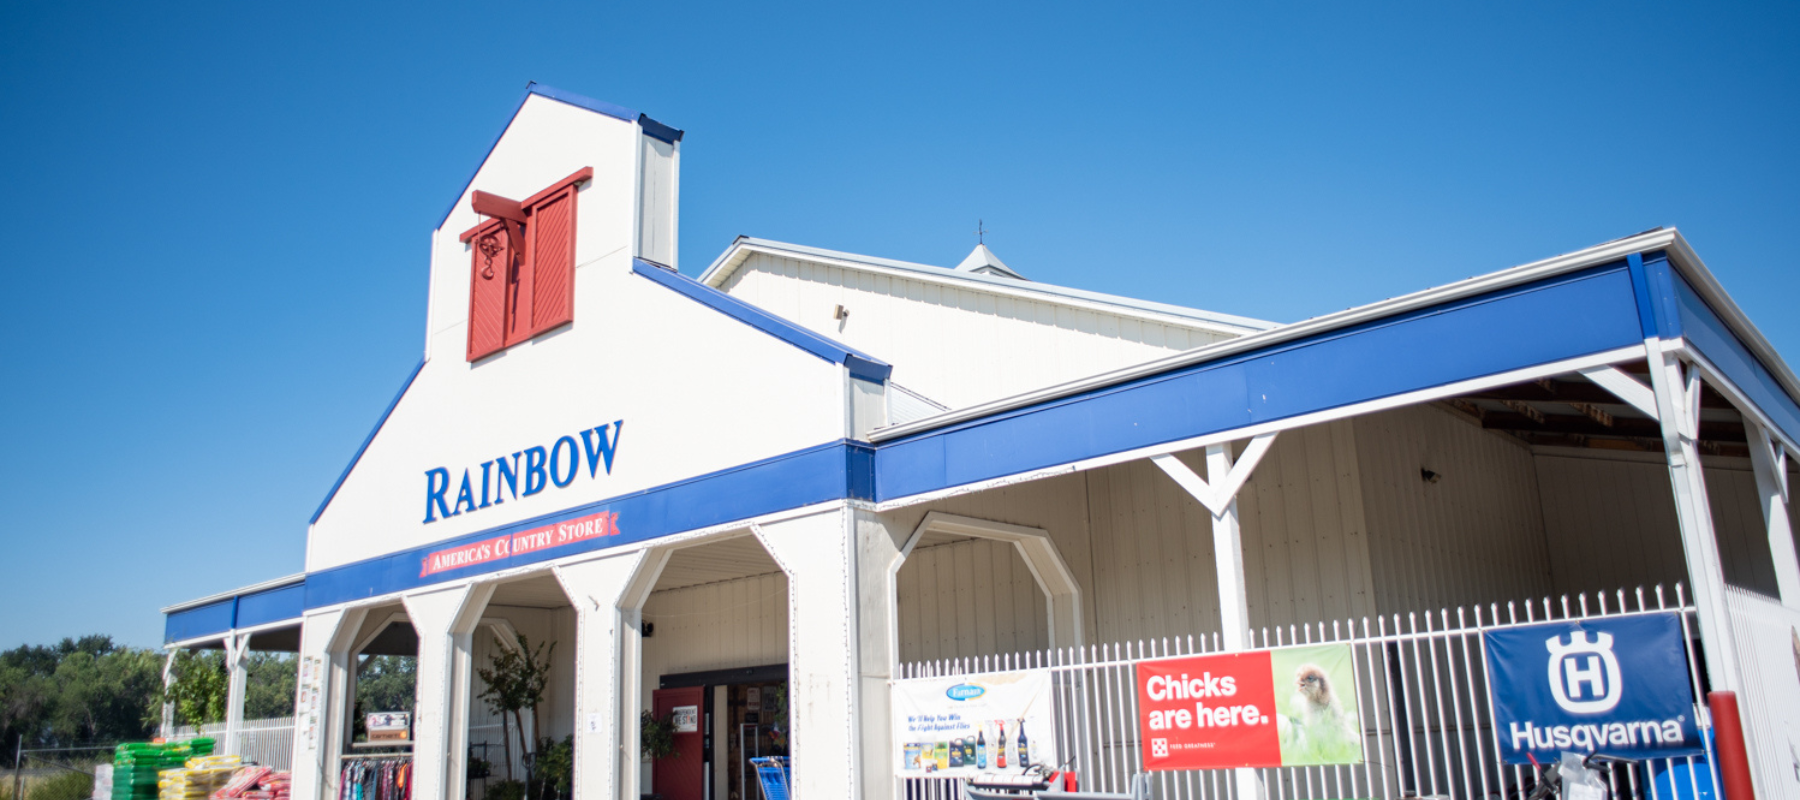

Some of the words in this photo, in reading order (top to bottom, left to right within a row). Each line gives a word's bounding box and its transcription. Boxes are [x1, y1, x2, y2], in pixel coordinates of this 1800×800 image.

[422, 419, 623, 524] RAINBOW
[432, 544, 491, 571] AMERICA'S
[495, 530, 554, 556] COUNTRY
[558, 517, 603, 542] STORE
[1146, 671, 1237, 701] Chicks
[1149, 708, 1192, 730] are
[1196, 702, 1269, 727] here.
